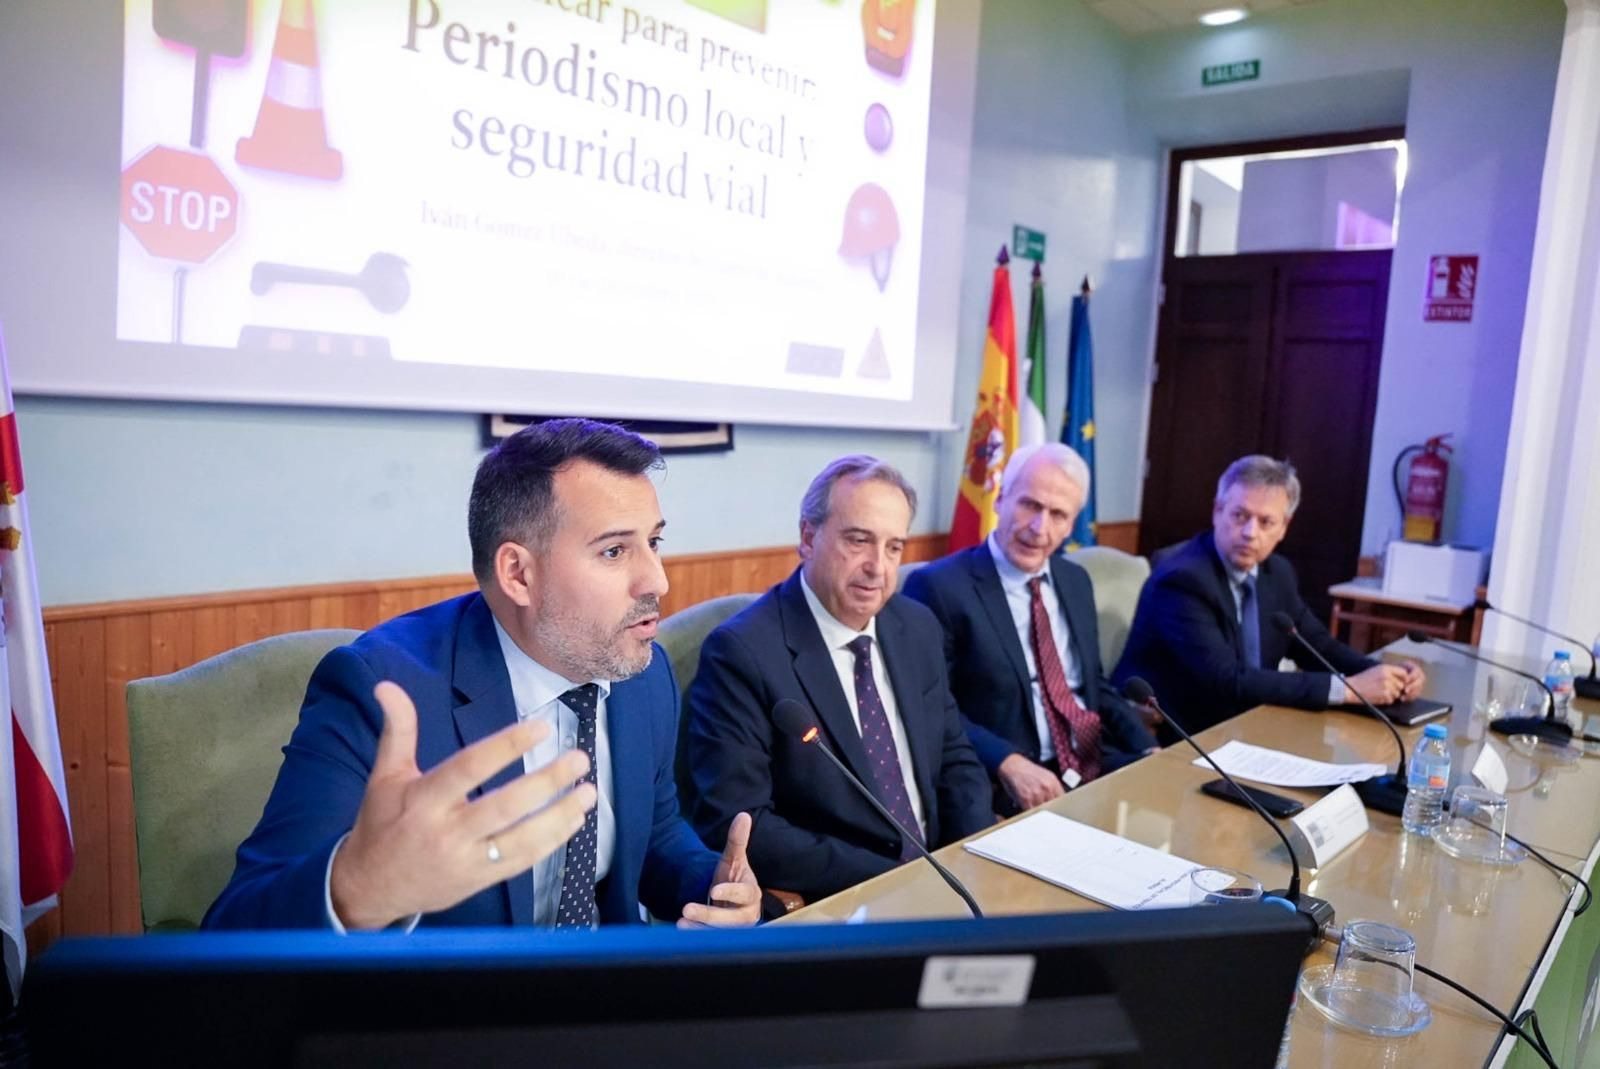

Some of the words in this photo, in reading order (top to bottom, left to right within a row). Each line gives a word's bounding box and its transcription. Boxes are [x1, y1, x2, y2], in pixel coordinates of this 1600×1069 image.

[621, 8, 689, 54] para
[401, 0, 689, 129] Periodismo
[704, 88, 786, 159] local
[798, 135, 815, 177] y
[450, 107, 689, 200] seguridad
[704, 164, 768, 219] vial
[130, 180, 231, 233] STOP
